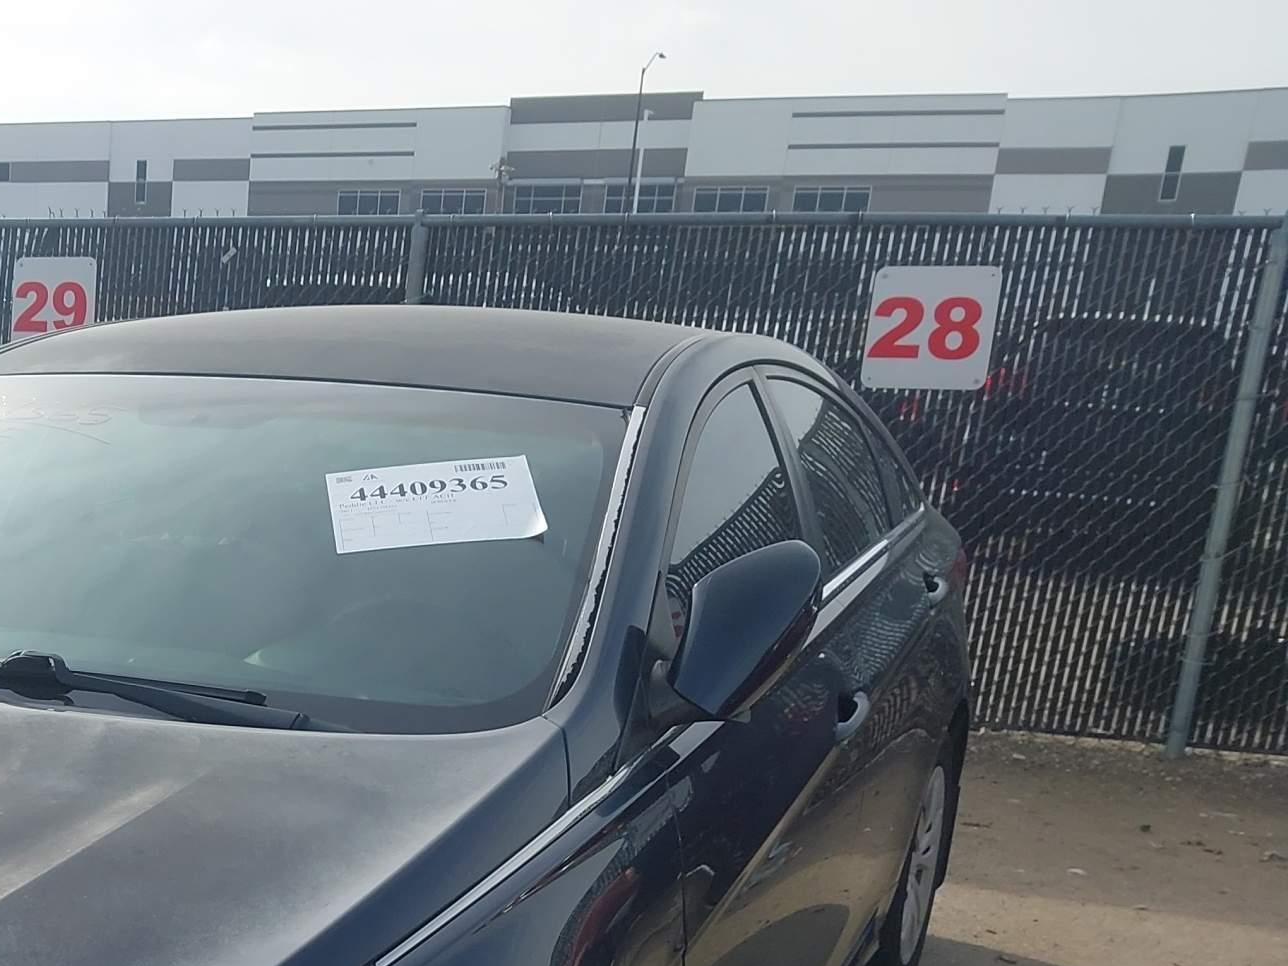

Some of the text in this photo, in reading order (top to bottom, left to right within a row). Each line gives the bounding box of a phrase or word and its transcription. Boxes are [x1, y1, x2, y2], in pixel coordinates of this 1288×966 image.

[13, 281, 87, 332] 29
[867, 296, 983, 360] 28
[350, 475, 508, 501] 44409365
